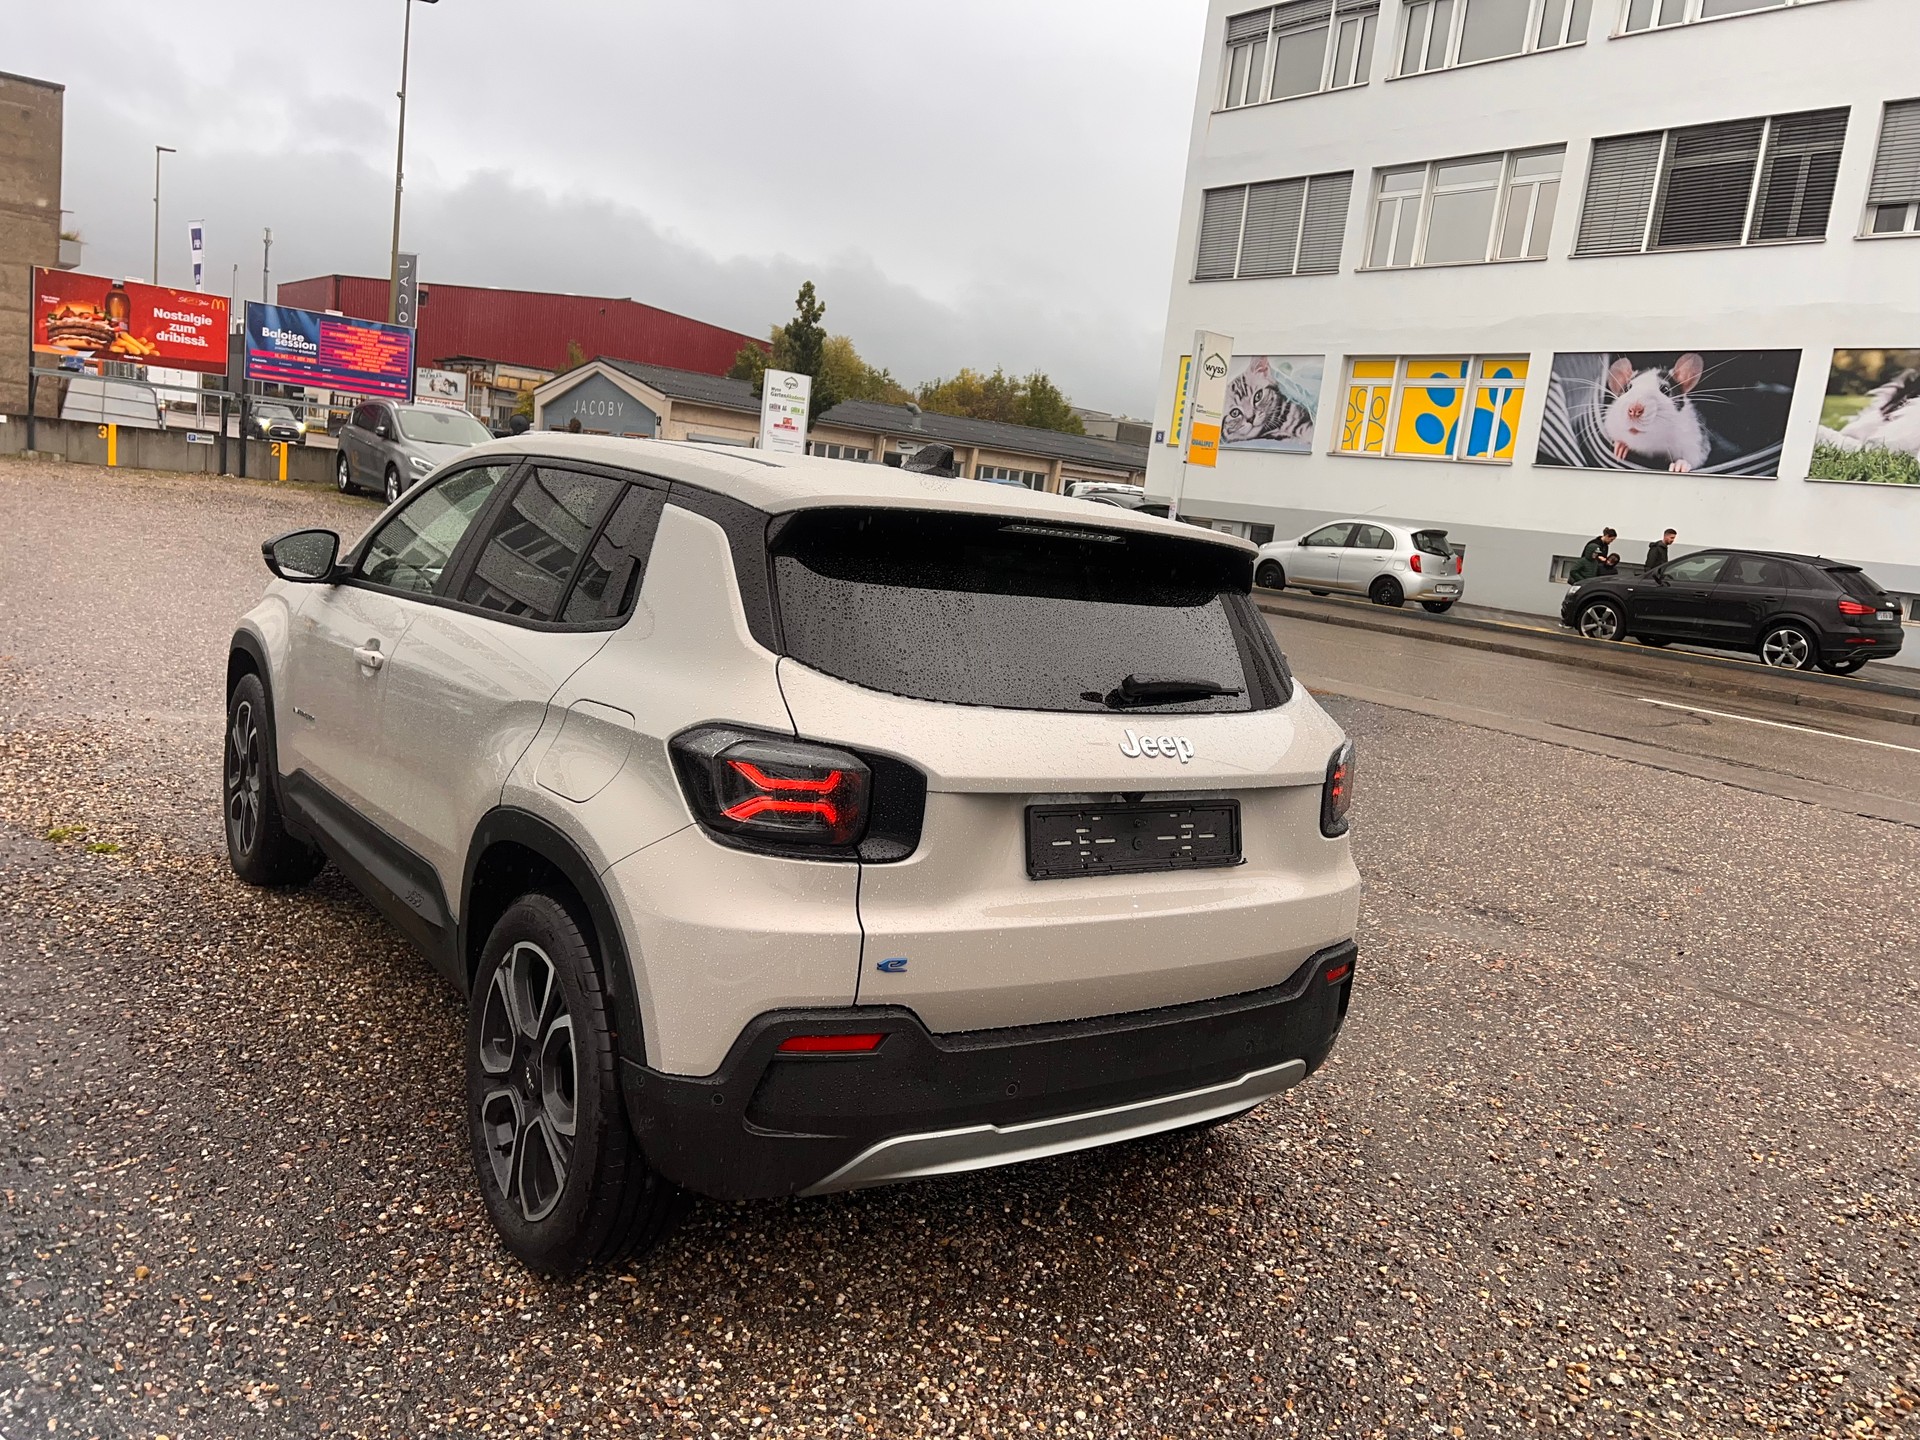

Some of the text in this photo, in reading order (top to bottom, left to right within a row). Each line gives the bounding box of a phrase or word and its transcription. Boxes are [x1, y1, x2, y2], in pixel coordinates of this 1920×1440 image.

[153, 308, 213, 327] Nostalgie
[169, 323, 197, 335] zum
[262, 327, 305, 342] Baloise
[156, 331, 209, 347] dribissä.
[275, 338, 317, 352] session
[1205, 364, 1224, 380] wyss
[573, 400, 624, 417] JACOBY
[656, 416, 662, 426] 12
[98, 424, 108, 439] 3
[1157, 432, 1163, 441] 8
[271, 443, 280, 457] 2
[1118, 729, 1195, 764] Jeep
